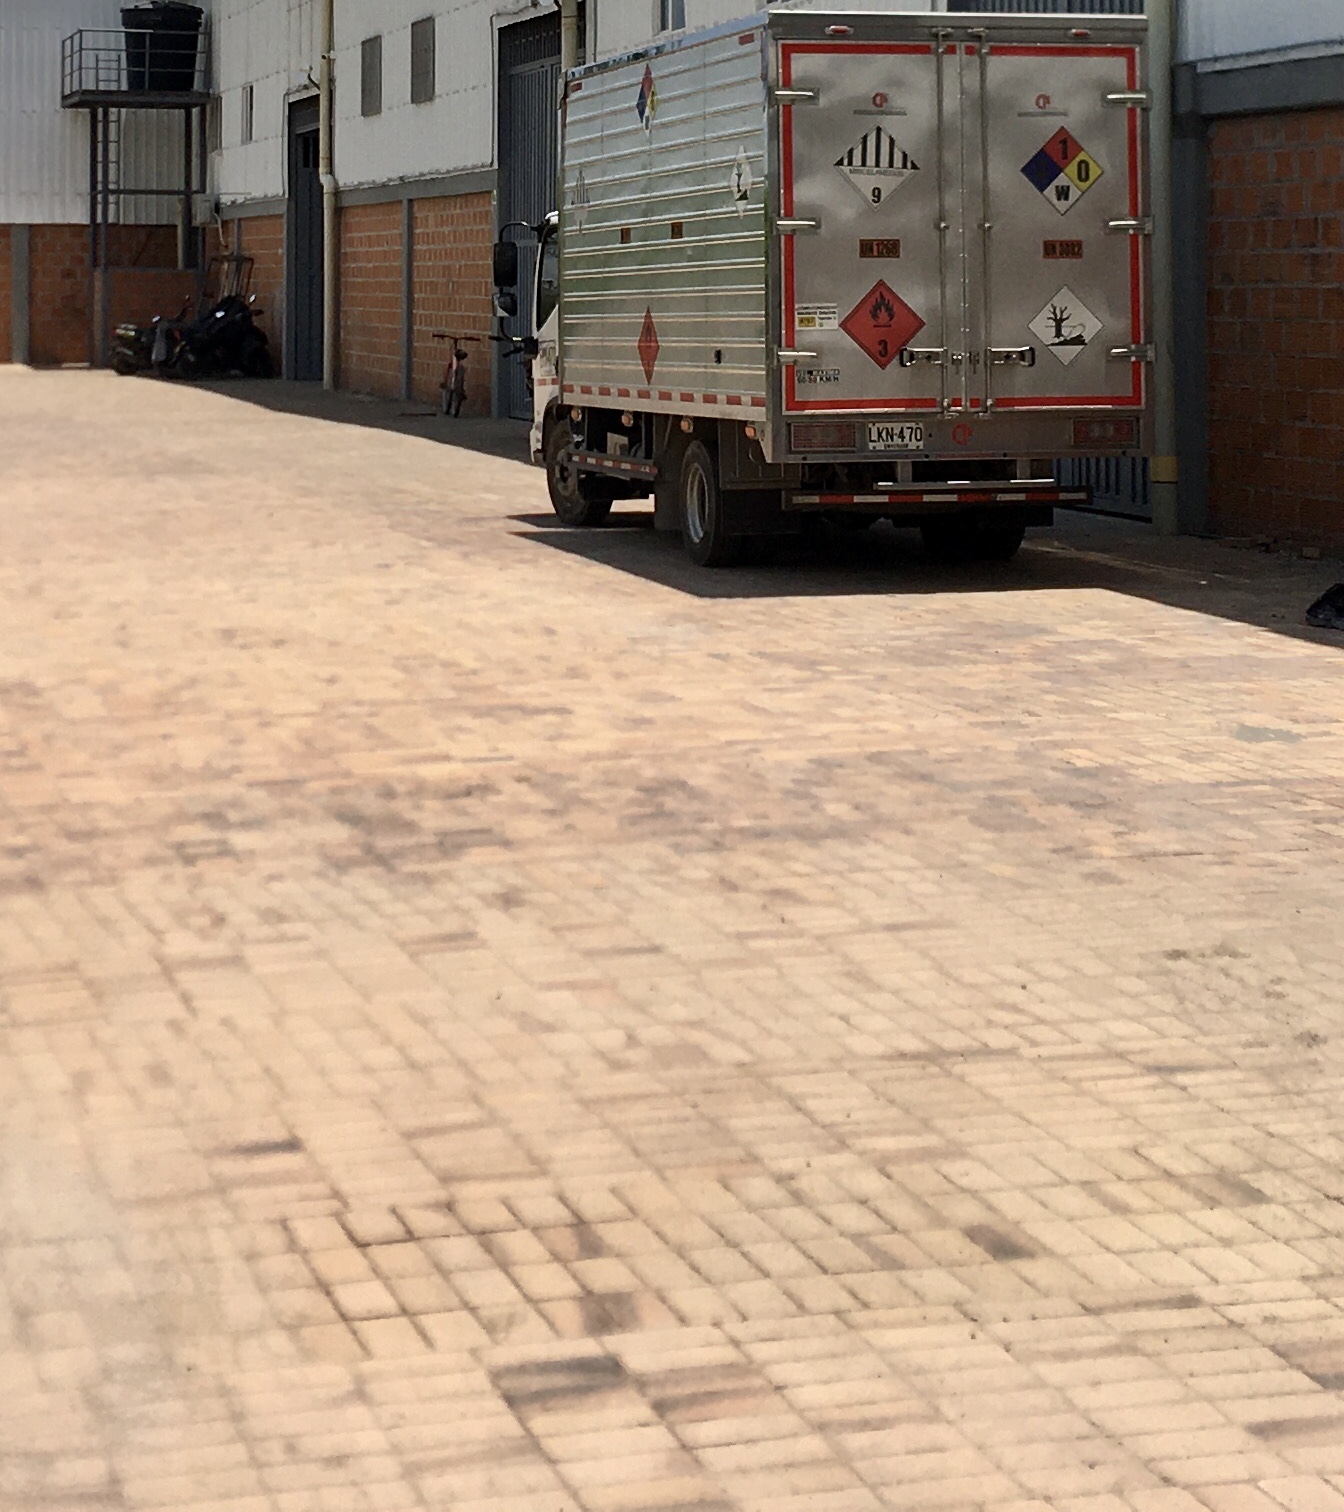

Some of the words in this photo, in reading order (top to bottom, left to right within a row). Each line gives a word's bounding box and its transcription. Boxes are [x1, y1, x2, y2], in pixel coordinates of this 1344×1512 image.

[1058, 137, 1068, 160] 1
[871, 186, 882, 204] 9
[1054, 185, 1071, 202] W
[878, 339, 889, 358] 3
